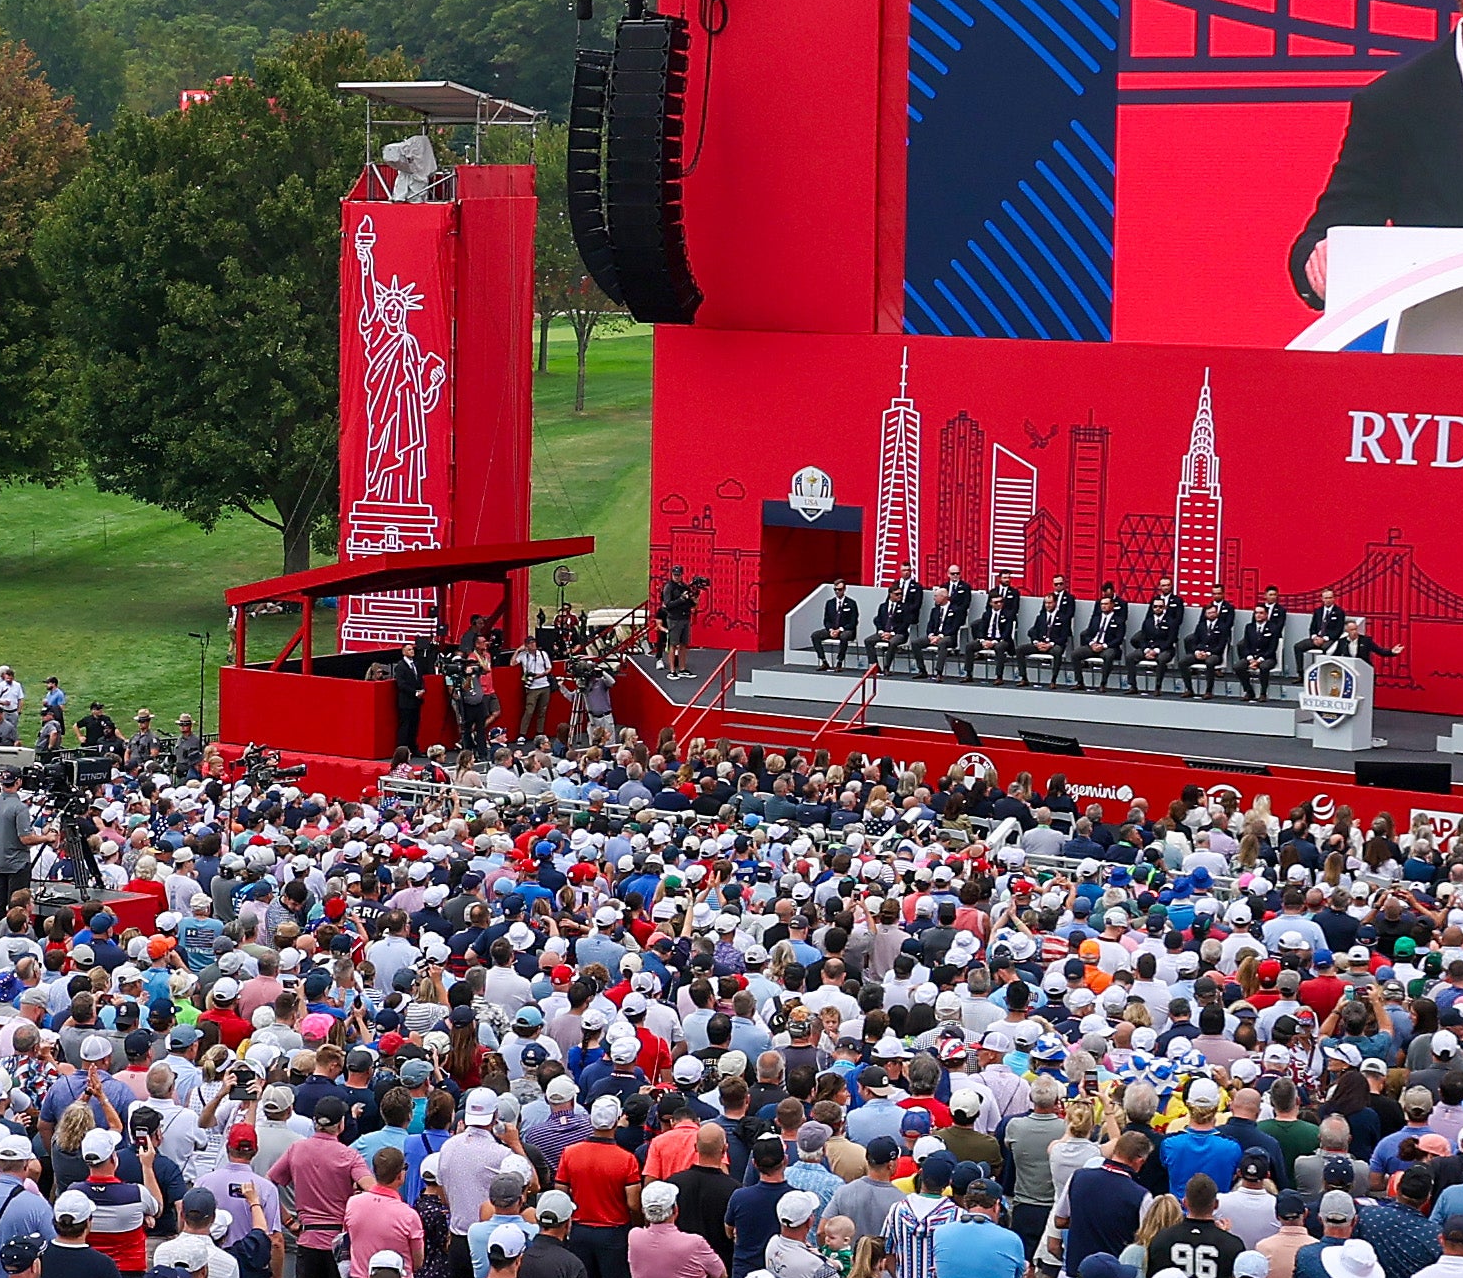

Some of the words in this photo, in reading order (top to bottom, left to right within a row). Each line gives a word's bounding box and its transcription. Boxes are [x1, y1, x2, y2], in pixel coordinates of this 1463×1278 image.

[1302, 697, 1333, 707] RYDER
[1334, 702, 1354, 711] CUP
[1428, 817, 1454, 838] AP
